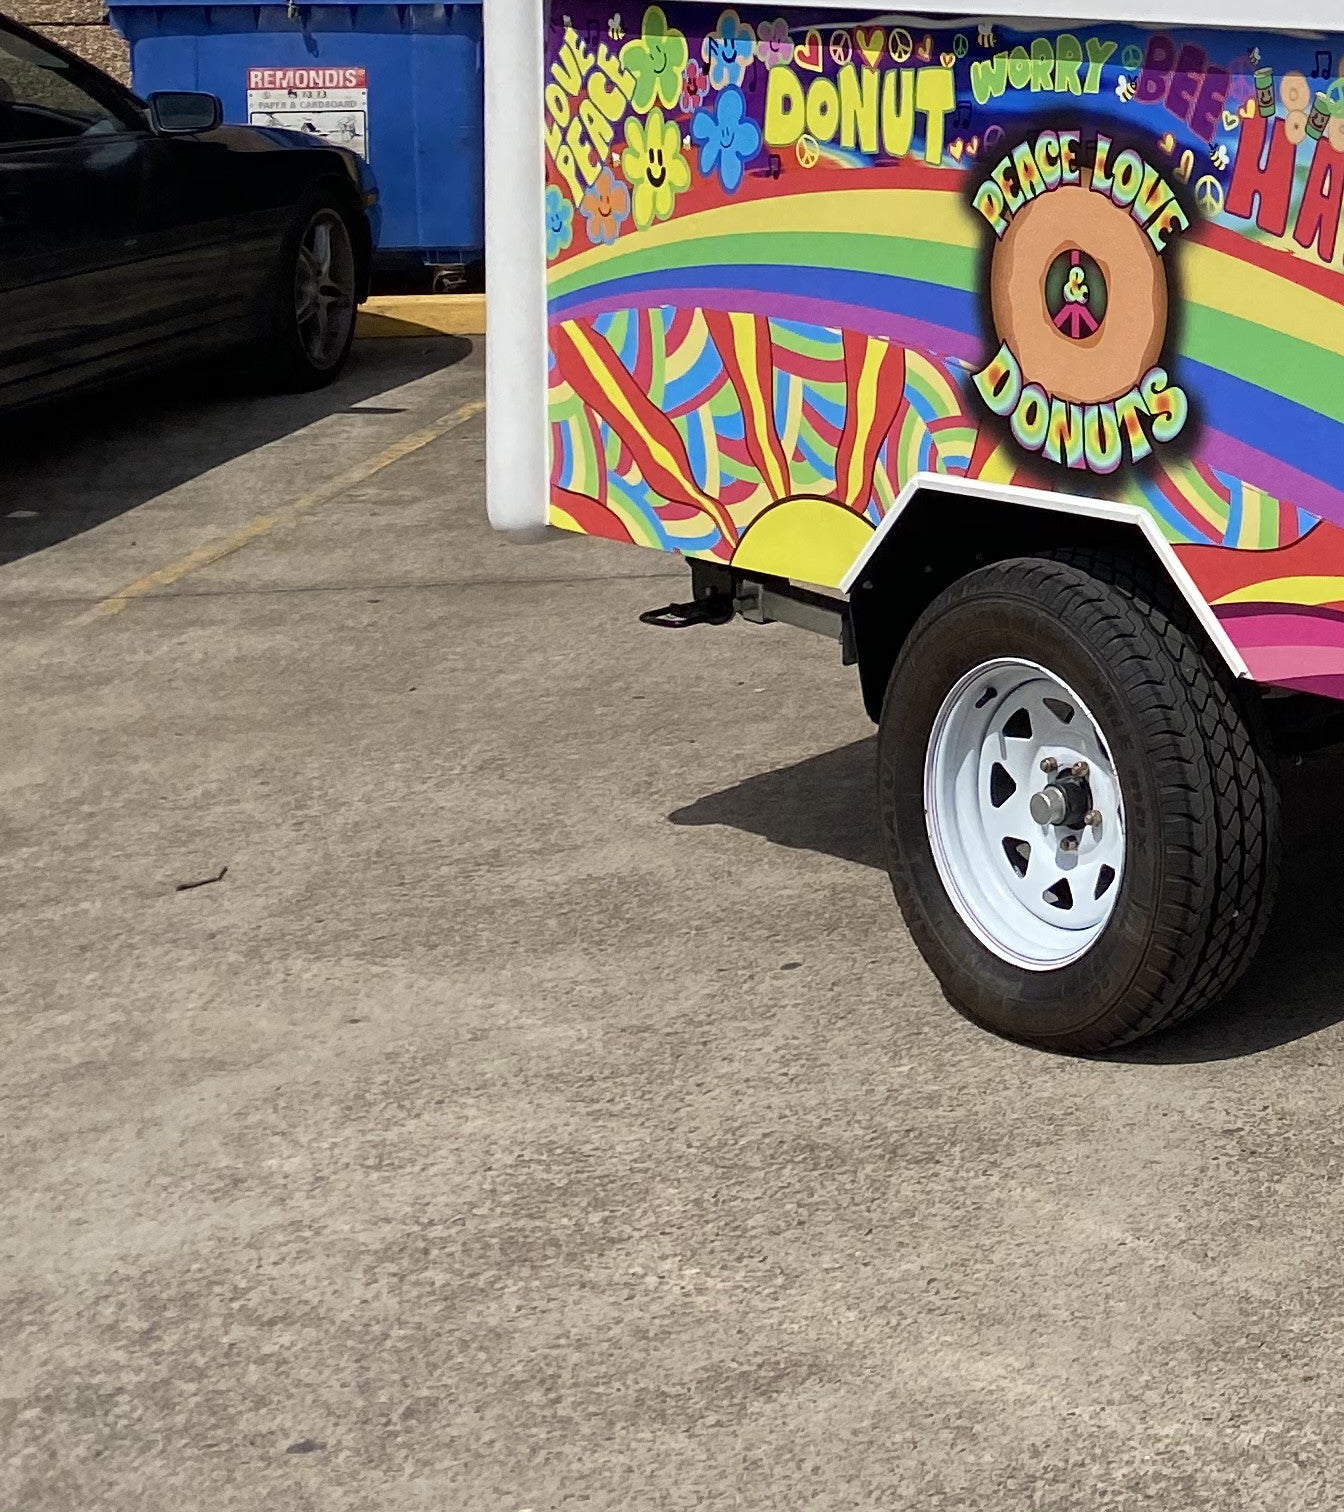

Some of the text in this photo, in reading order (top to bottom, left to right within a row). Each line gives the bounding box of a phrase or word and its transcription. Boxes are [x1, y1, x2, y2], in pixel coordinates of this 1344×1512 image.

[250, 69, 357, 89] REMONDIS
[556, 43, 637, 208] PEACE
[764, 64, 957, 166] DONUT
[970, 34, 1119, 105] WORRY
[1136, 34, 1232, 144] BEE
[971, 130, 1190, 252] PEACE LOVE
[1063, 266, 1090, 305] &
[970, 340, 1188, 474] DONUTS
